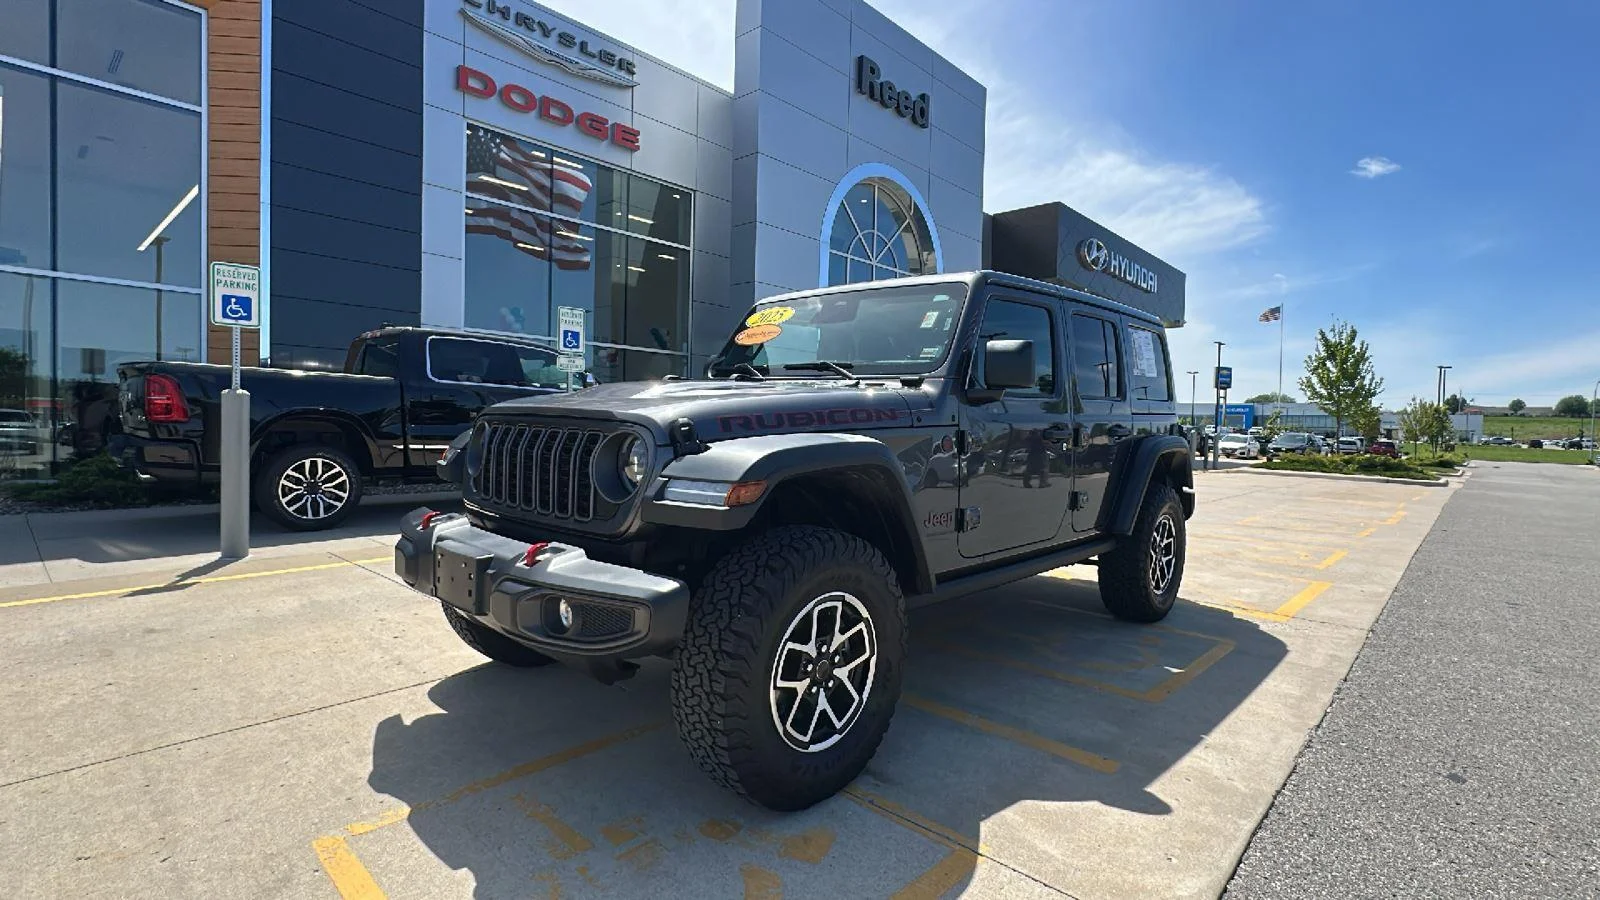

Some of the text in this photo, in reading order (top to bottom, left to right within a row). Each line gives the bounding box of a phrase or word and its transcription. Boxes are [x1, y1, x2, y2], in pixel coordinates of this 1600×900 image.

[857, 55, 930, 128] Reed
[457, 65, 640, 152] DODGE
[216, 268, 256, 280] RESERVED
[1111, 251, 1157, 293] HYUNDAI
[216, 279, 257, 291] PARKING
[719, 408, 898, 432] RUBICON
[924, 512, 953, 528] Jeep
